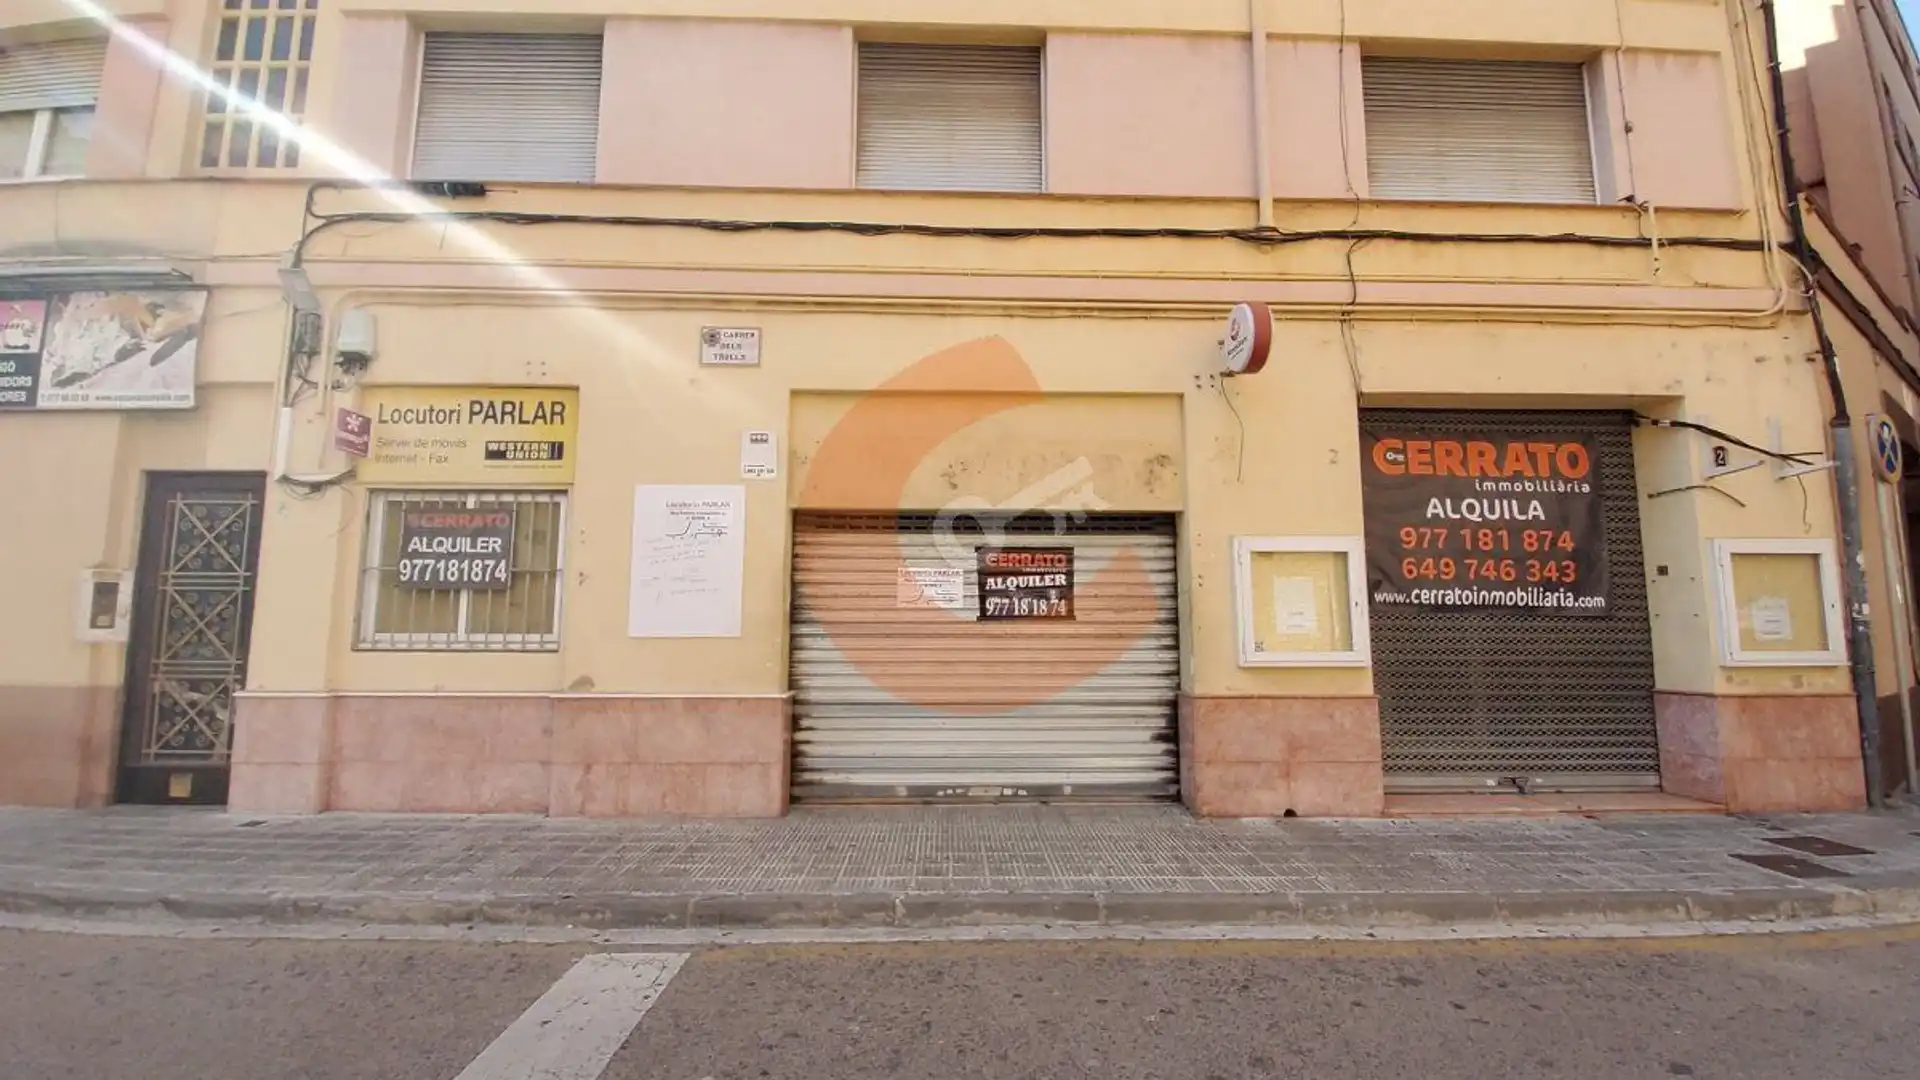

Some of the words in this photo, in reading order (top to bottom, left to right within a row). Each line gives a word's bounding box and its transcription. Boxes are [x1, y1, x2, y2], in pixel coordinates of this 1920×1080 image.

[723, 331, 755, 339] CARRER
[377, 402, 461, 425] Locutori
[468, 400, 566, 425] PARLAR
[414, 437, 429, 449] de
[488, 442, 549, 451] WESTERN
[374, 453, 417, 464] Internet
[428, 453, 449, 464] Fax
[505, 450, 548, 460] UNION
[1372, 438, 1590, 479] CERRATO
[1426, 498, 1546, 521] ALQUILA
[420, 512, 510, 528] CERRATO
[408, 535, 502, 553] ALQUILER
[1400, 527, 1448, 549] 977
[1460, 528, 1509, 550] 181
[1523, 530, 1575, 552] 874
[986, 552, 1067, 567] CERRATO
[399, 559, 507, 582] 977181874
[1402, 557, 1456, 580] 649
[1464, 559, 1517, 582] 746
[1526, 560, 1577, 583] 343
[985, 573, 1067, 590] ALQUILER
[1374, 585, 1606, 608] www.cerratoinmobiliaria.com
